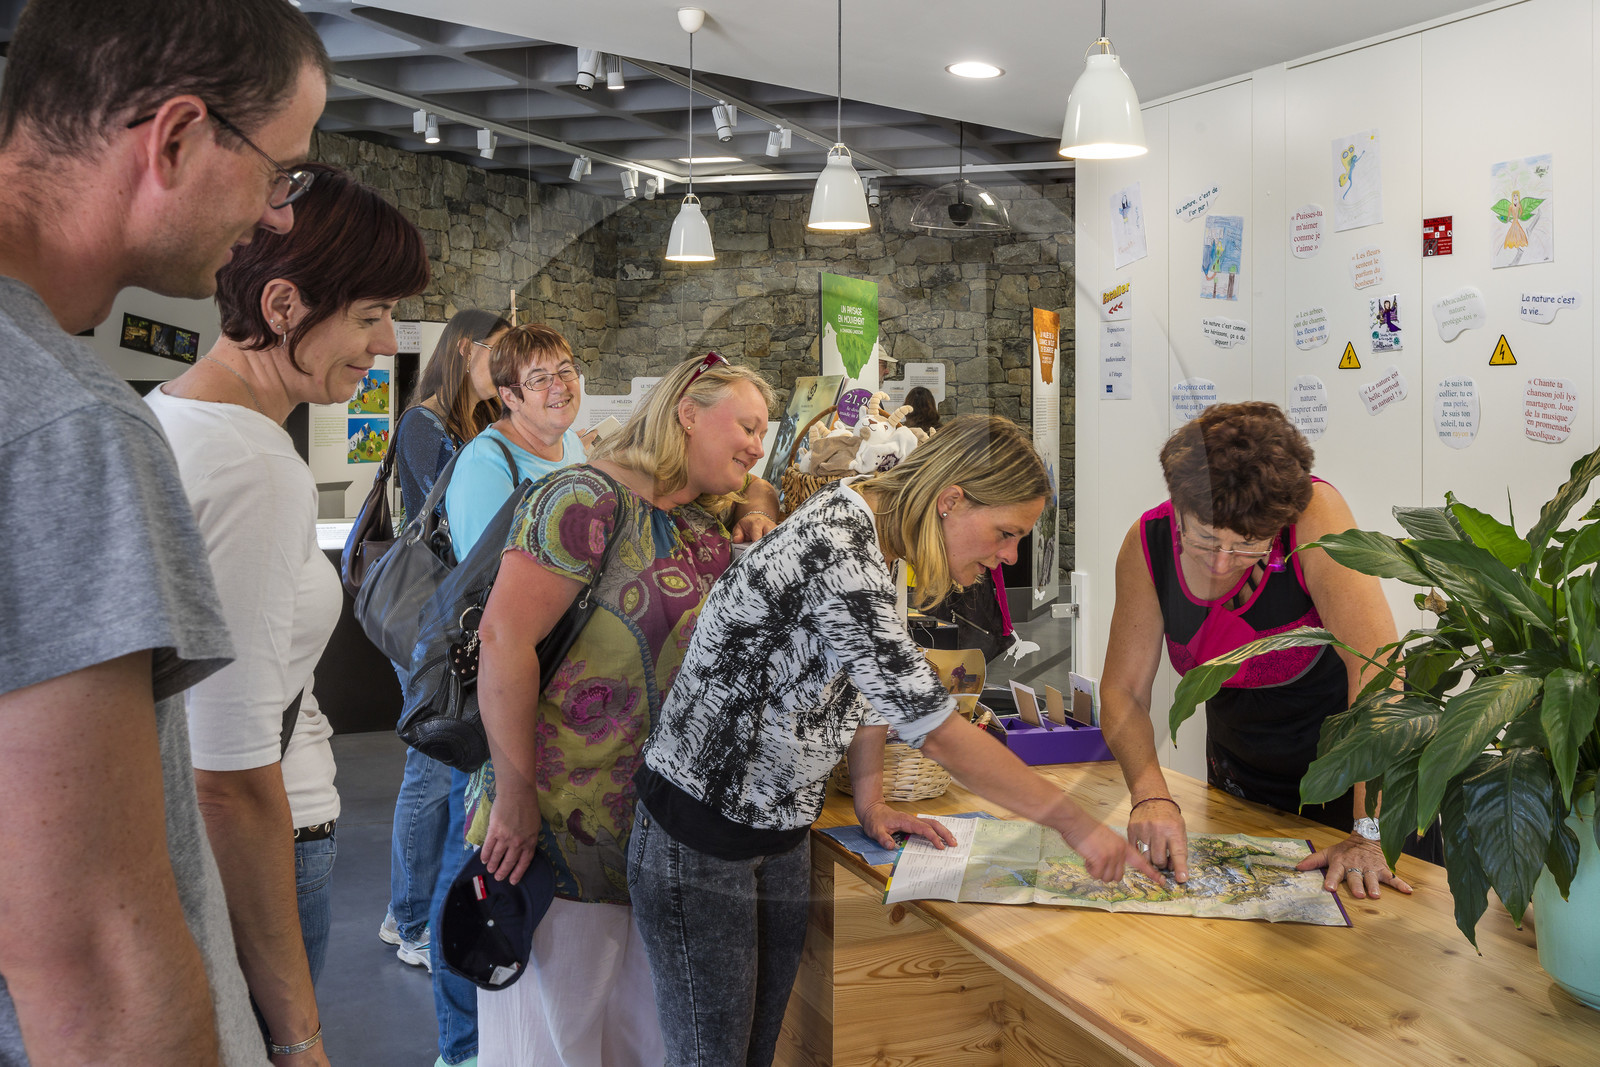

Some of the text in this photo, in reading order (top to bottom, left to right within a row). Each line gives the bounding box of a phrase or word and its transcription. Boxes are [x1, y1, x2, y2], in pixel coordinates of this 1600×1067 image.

[1295, 210, 1323, 220] Puisses-tu
[1295, 221, 1318, 231] m'aimer
[1293, 231, 1321, 242] comme je
[1355, 269, 1373, 280] parfum
[1102, 282, 1131, 305] Escalier
[1521, 293, 1576, 305] La nature c'est
[840, 305, 863, 316] UN PAYSAGE
[1299, 311, 1309, 319] Les
[1448, 305, 1467, 315] nature
[1520, 305, 1528, 315] la
[837, 314, 865, 326] EN MOUVEMENT
[1208, 320, 1221, 328] nature
[1221, 322, 1232, 330] c'est
[1232, 324, 1247, 332] comme
[1296, 324, 1326, 337] les fleurs ont
[1295, 338, 1304, 346] des
[1298, 383, 1316, 391] Puisse
[1316, 381, 1323, 390] la
[1367, 385, 1376, 393] La
[1375, 376, 1391, 388] nature
[1390, 370, 1399, 379] est
[1443, 379, 1451, 388] Je
[1450, 379, 1463, 388] suis
[1533, 378, 1556, 388] Chante
[1556, 381, 1563, 389] ta
[1367, 380, 1400, 403] belle, surtout
[1438, 389, 1460, 398] collier,
[1526, 388, 1576, 403] chanson joli lys
[1377, 392, 1395, 408] naturel
[1452, 399, 1469, 409] perle,
[1290, 403, 1328, 414] inspirer enfin
[1525, 400, 1574, 412] martagon. Joue
[1441, 409, 1448, 418] Je
[1448, 409, 1461, 417] suis
[1524, 409, 1569, 423] de la musique
[1294, 416, 1300, 424] la
[1300, 416, 1313, 425] paix
[1440, 419, 1458, 428] soleil,
[1535, 420, 1571, 433] promenade
[1452, 431, 1469, 440] rayon
[1525, 427, 1557, 441] bucolique
